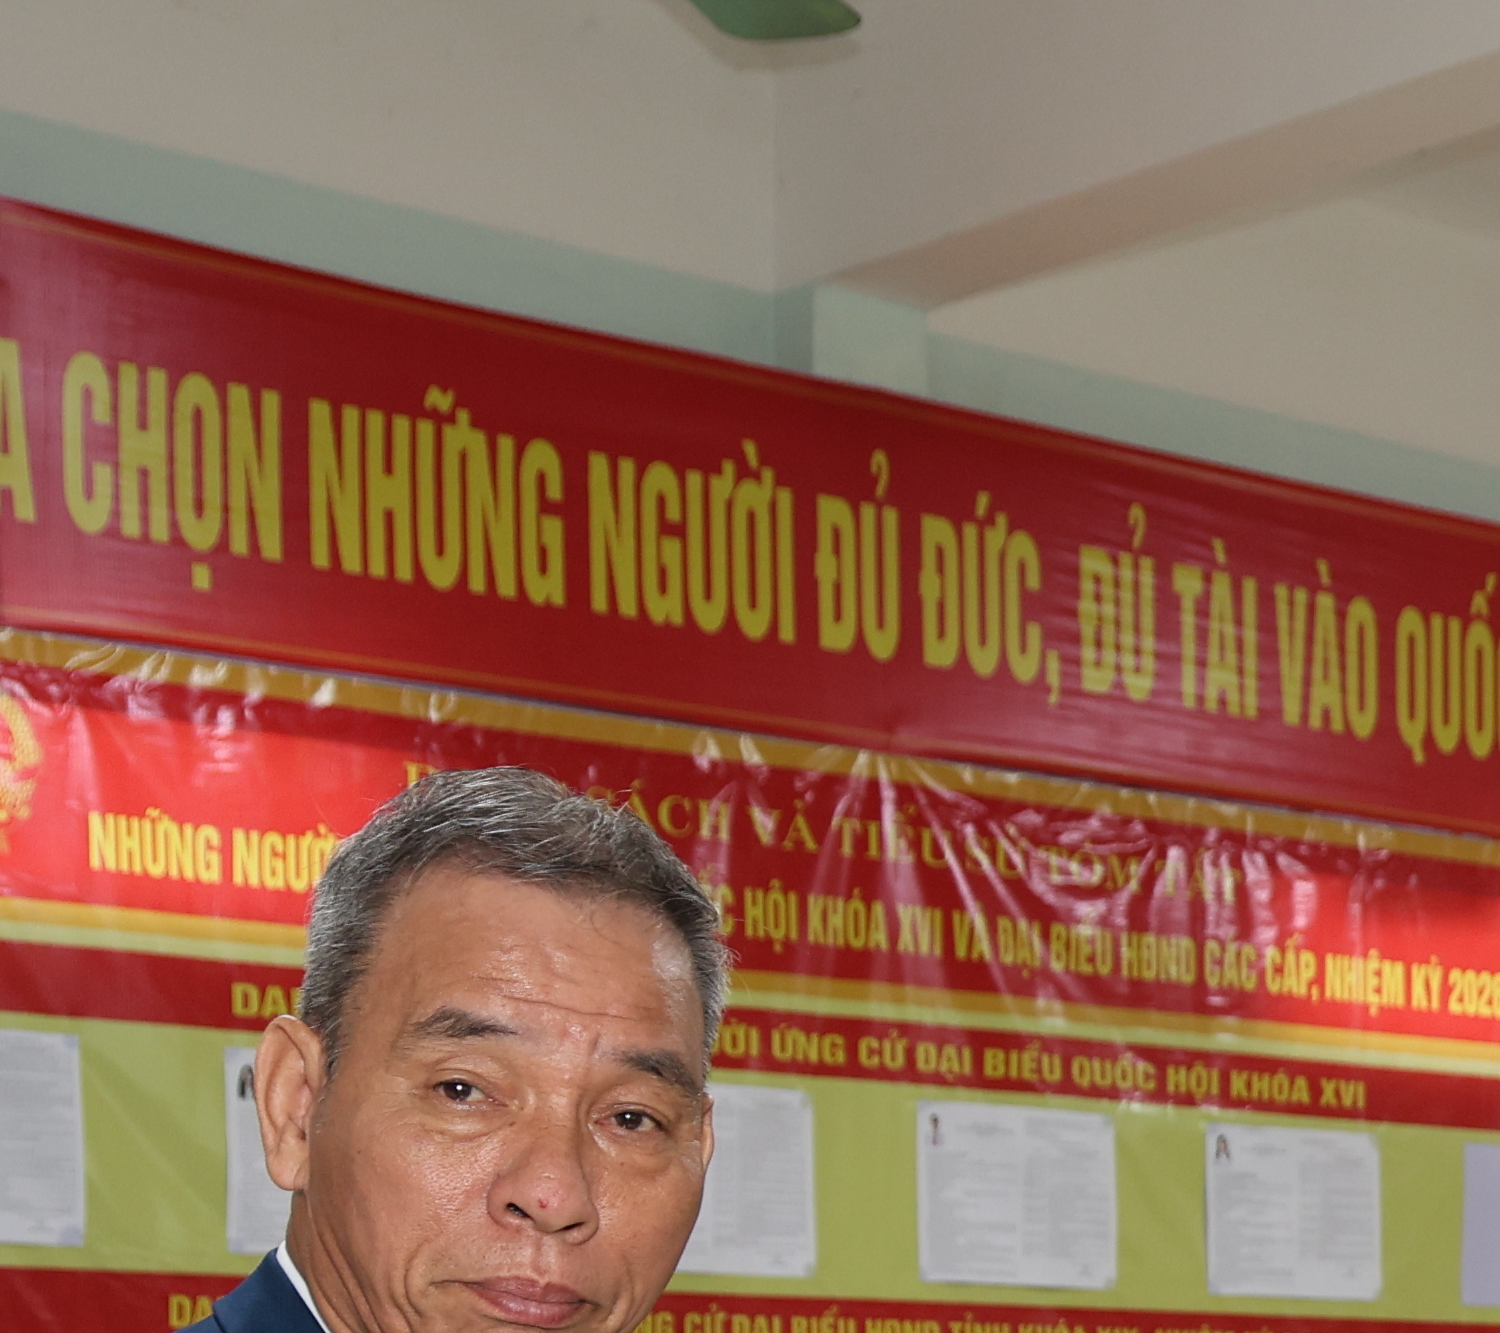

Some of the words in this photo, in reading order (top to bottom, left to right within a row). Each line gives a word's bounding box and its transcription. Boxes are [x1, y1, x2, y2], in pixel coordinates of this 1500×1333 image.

[62, 348, 282, 591] CHỌN
[310, 386, 565, 606] NHỮNG
[587, 440, 795, 642] NGƯỜI
[816, 448, 900, 660] ĐỦ
[919, 490, 1060, 704] ĐỨC,
[1078, 503, 1156, 702] ĐỦ
[1173, 537, 1260, 719] TÀI
[1274, 560, 1378, 739] VÀO
[748, 801, 818, 854] VÀ
[89, 808, 220, 884] NHỮNG
[744, 878, 799, 953] HỘI
[808, 887, 888, 949] KHÓA
[897, 904, 943, 957] XVI
[997, 920, 1041, 980] ĐẠI
[1051, 914, 1113, 978] BIỂU
[1121, 932, 1197, 985] HĐND
[1204, 934, 1256, 990] CÁC
[1265, 931, 1319, 1001] CẤP,
[1325, 949, 1405, 1016] NHIỆM
[1412, 956, 1441, 1011] KỲ
[770, 1022, 846, 1066] ỨNG
[857, 1027, 910, 1071] CỬ
[983, 1038, 1063, 1085] BIỂU
[1072, 1037, 1155, 1091] QUỐC
[1166, 1060, 1220, 1101] HỘI
[1230, 1066, 1310, 1105] KHÓA
[1319, 1078, 1366, 1110] XVI
